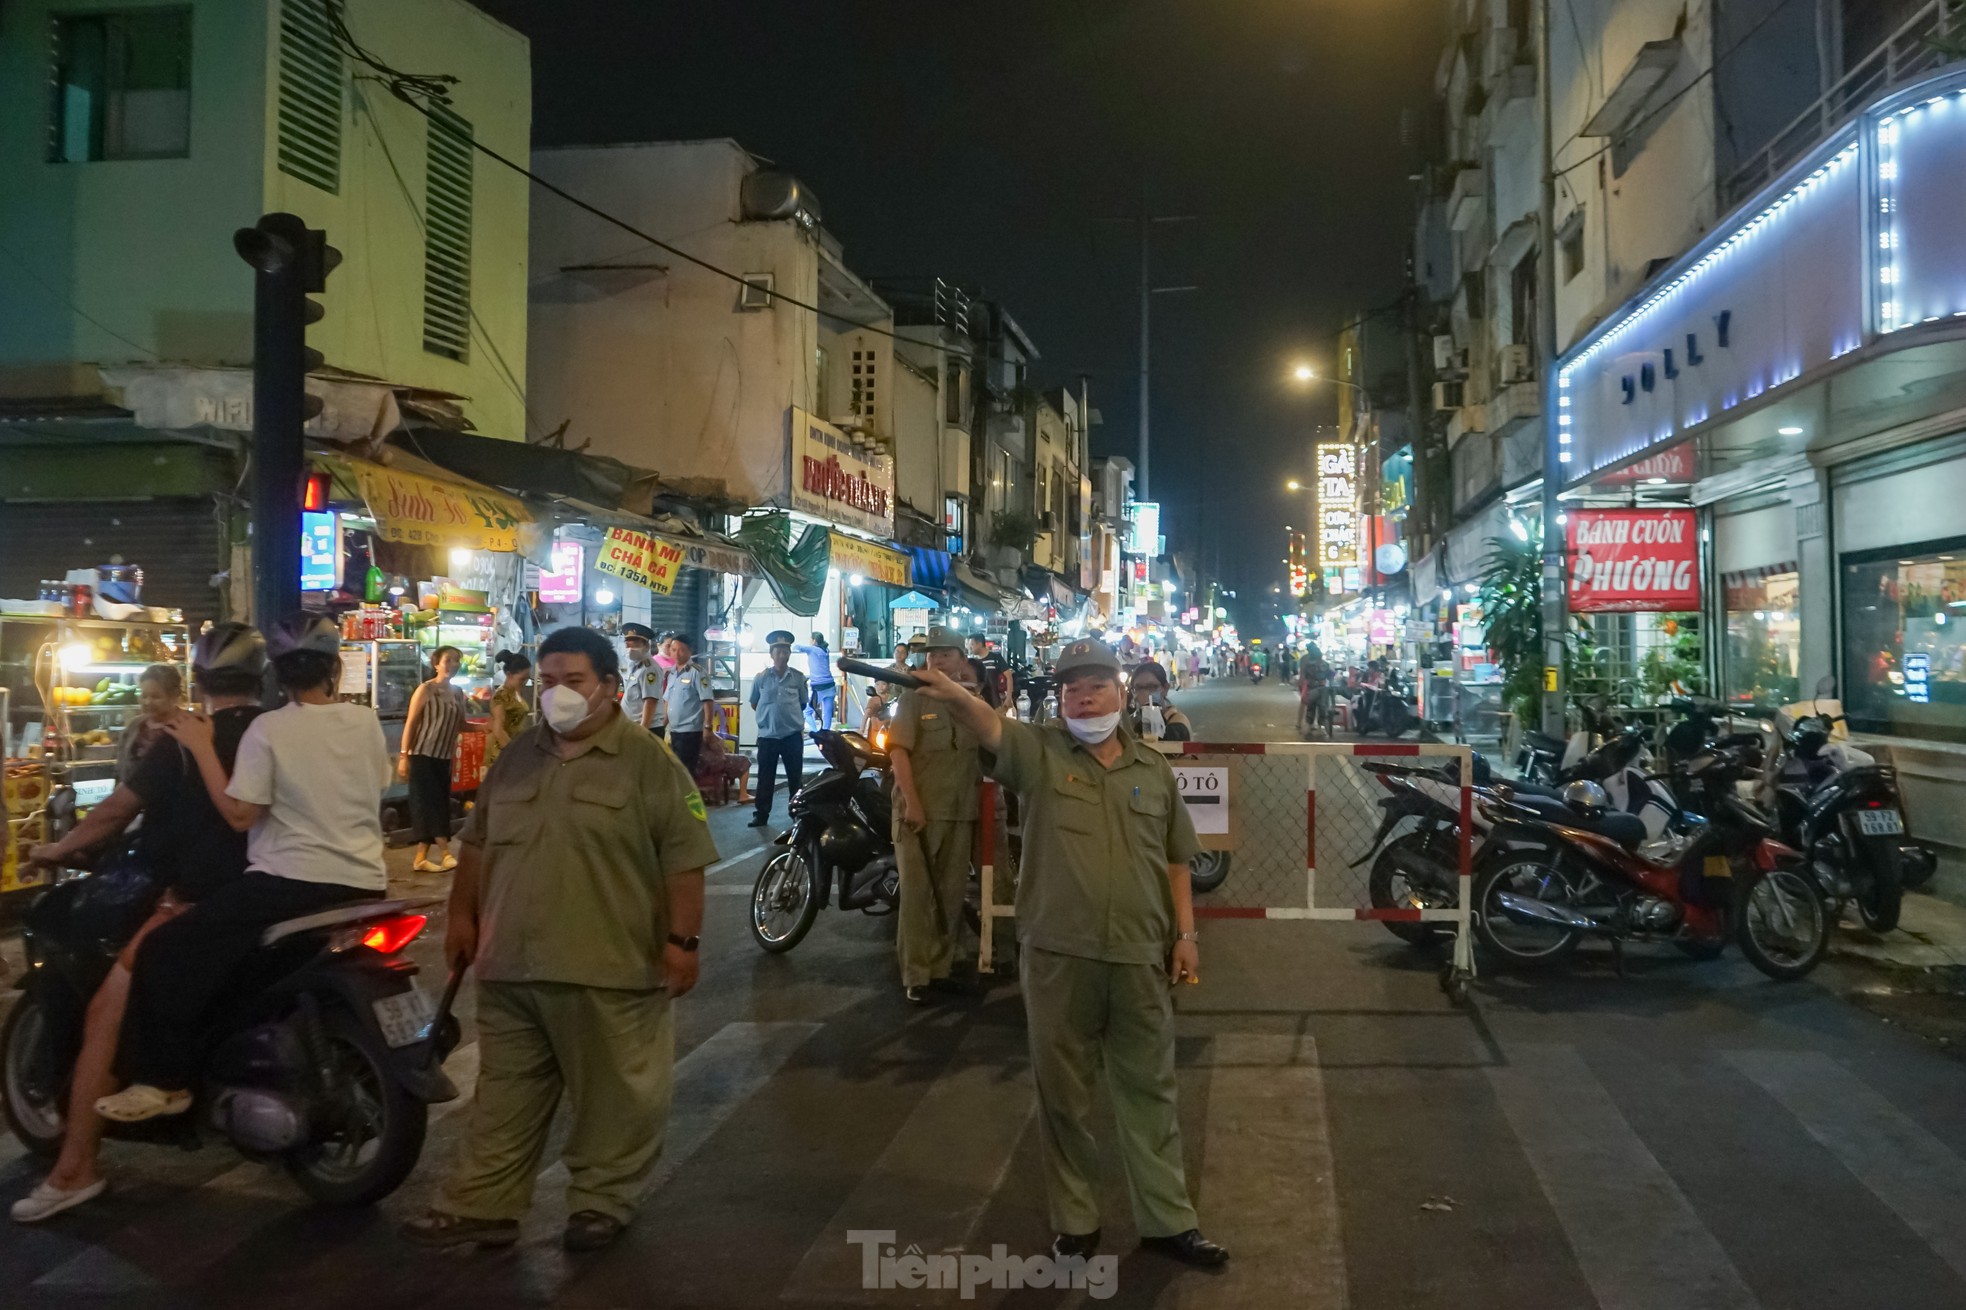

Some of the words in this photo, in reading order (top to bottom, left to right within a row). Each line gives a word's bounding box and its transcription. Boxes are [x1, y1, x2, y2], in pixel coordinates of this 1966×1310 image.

[1323, 477, 1349, 497] TA
[1631, 511, 1685, 545] CUỐN
[610, 546, 643, 569] CHẢ
[620, 566, 648, 585] 135A
[1193, 772, 1219, 791] TÔ
